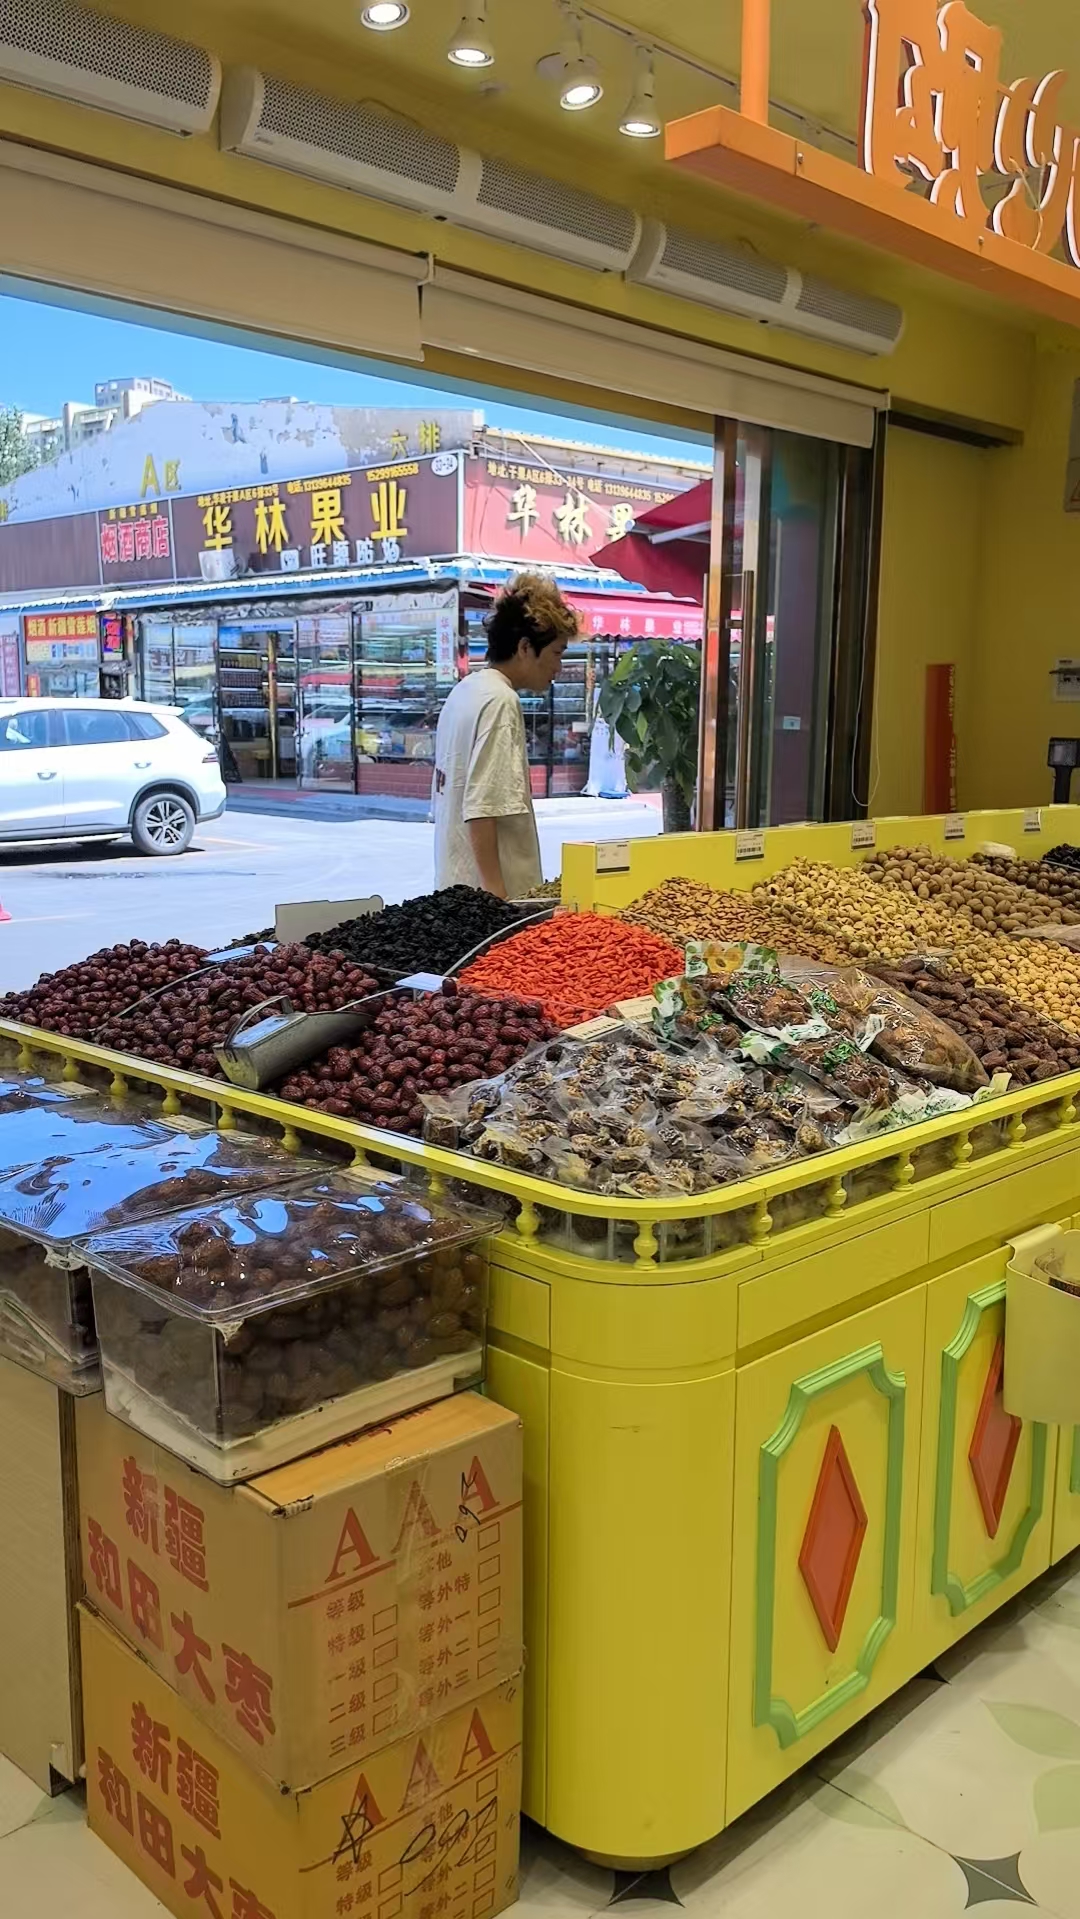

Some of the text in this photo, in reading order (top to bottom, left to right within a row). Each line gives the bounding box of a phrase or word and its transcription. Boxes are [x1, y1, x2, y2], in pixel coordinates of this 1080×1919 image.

[390, 420, 442, 461] 六排
[202, 480, 409, 554] 华林果业
[506, 483, 635, 545] 华林果
[101, 515, 170, 564] 烟酒商店
[123, 1455, 209, 1593] 新疆
[326, 1589, 366, 1620] 等级
[88, 1516, 276, 1746] 和田大枣
[328, 1623, 367, 1656] 特级
[328, 1690, 367, 1724] 二级
[328, 1722, 367, 1758] 三级
[131, 1700, 222, 1840] 新疆
